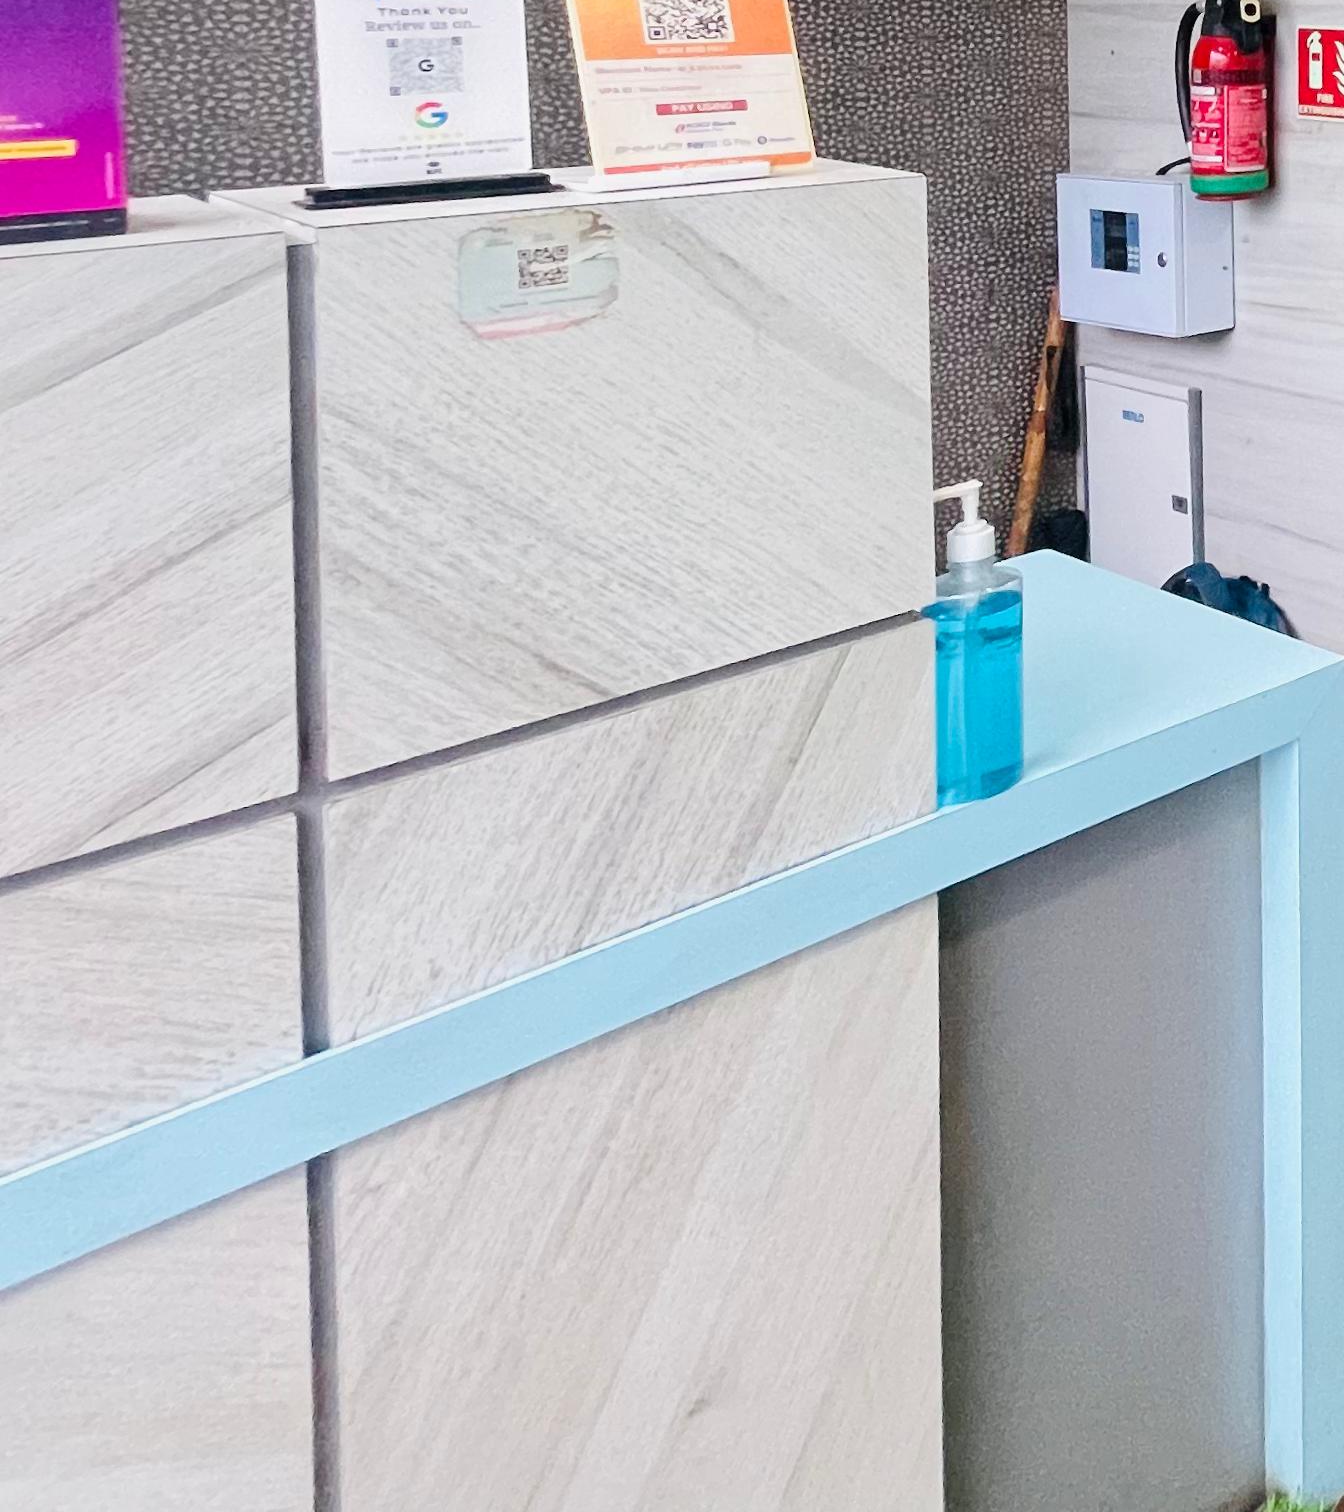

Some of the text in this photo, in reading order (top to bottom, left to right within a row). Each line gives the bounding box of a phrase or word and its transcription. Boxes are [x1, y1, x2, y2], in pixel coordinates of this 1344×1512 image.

[377, 6, 469, 17] Thank You
[671, 103, 694, 113] PAY
